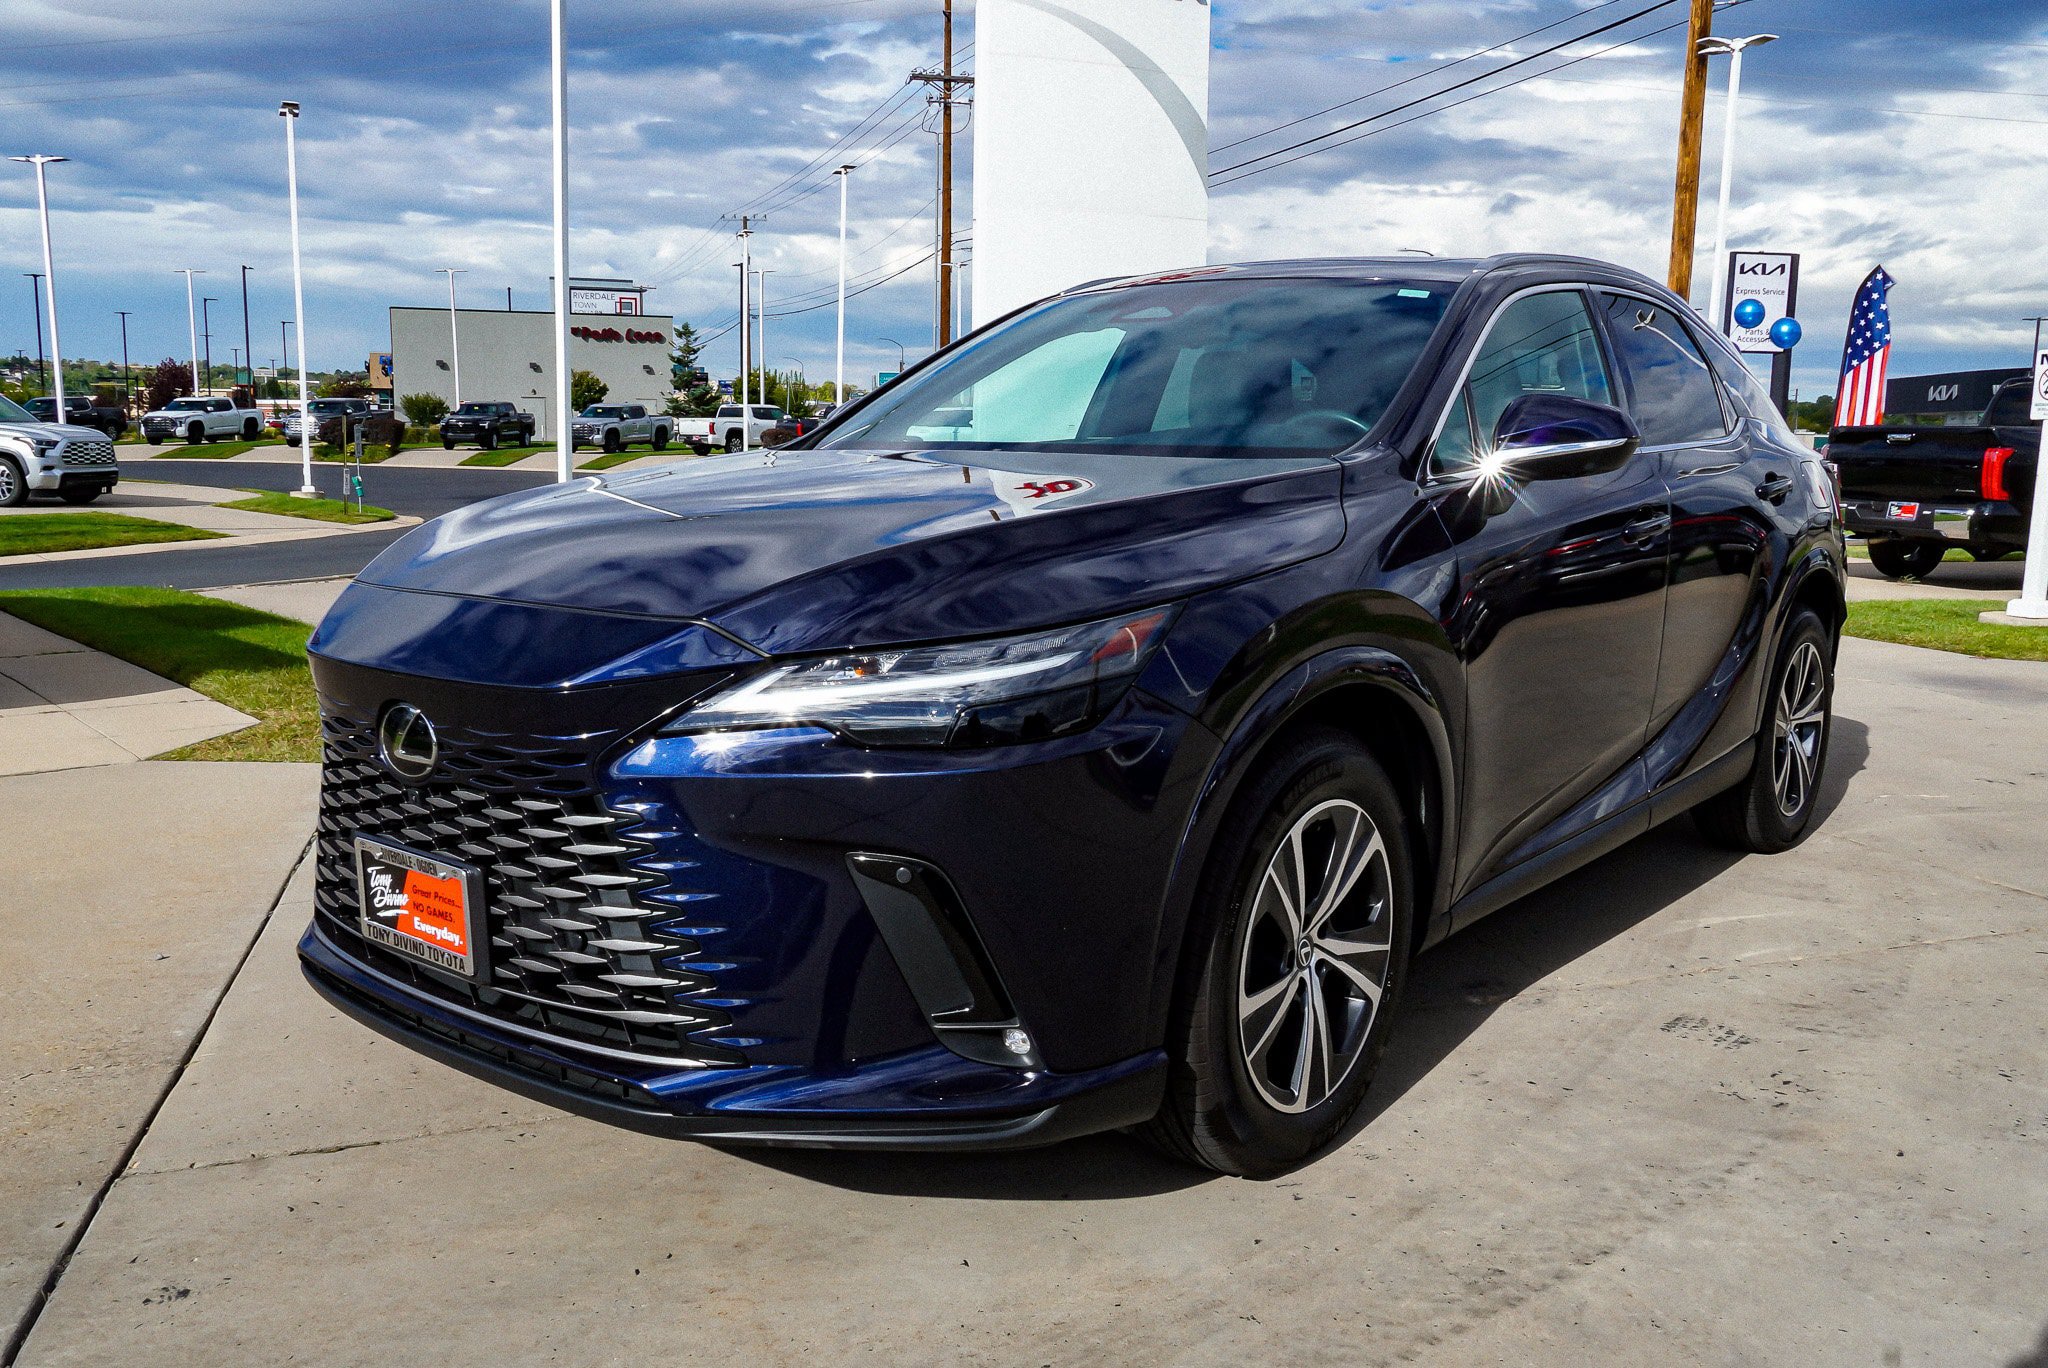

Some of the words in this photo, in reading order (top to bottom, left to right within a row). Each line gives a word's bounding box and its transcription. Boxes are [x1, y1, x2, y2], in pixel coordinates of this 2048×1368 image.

[1740, 262, 1786, 276] KIA
[573, 291, 615, 301] RIVERDALE
[1735, 287, 1760, 296] Express
[1762, 287, 1786, 296] Service
[1927, 384, 1958, 402] KIA
[367, 866, 392, 891] Tony
[370, 886, 409, 907] Divino
[412, 885, 432, 899] Great
[413, 901, 425, 913] NO
[427, 905, 456, 923] GAMES.
[413, 917, 464, 946] Everyday.
[367, 924, 391, 943] TONY
[393, 935, 425, 957] DIVINO
[427, 946, 466, 973] TOYOTA
